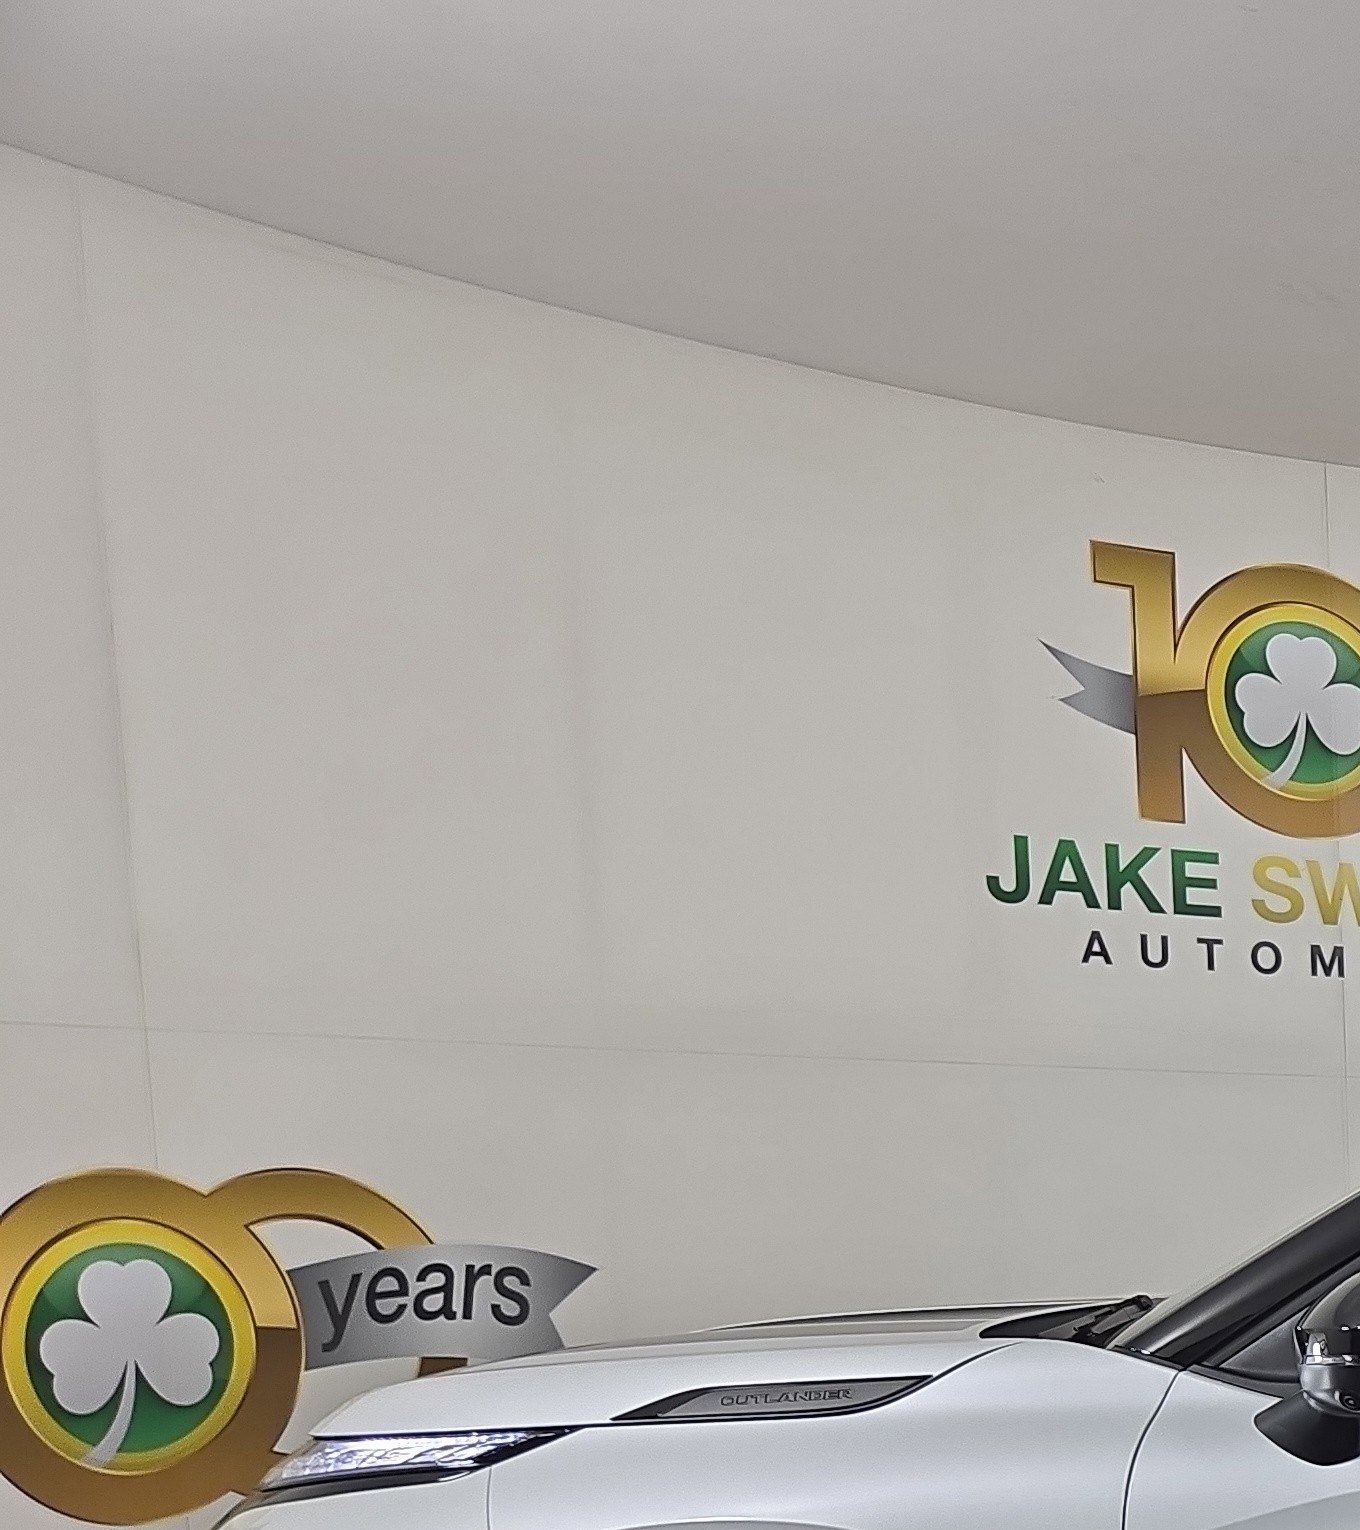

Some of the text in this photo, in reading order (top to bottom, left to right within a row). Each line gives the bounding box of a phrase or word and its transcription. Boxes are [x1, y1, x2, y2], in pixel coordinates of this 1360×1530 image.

[985, 833, 1223, 919] JAKE
[317, 1261, 532, 1353] years
[720, 1388, 854, 1407] OUTLANDER
